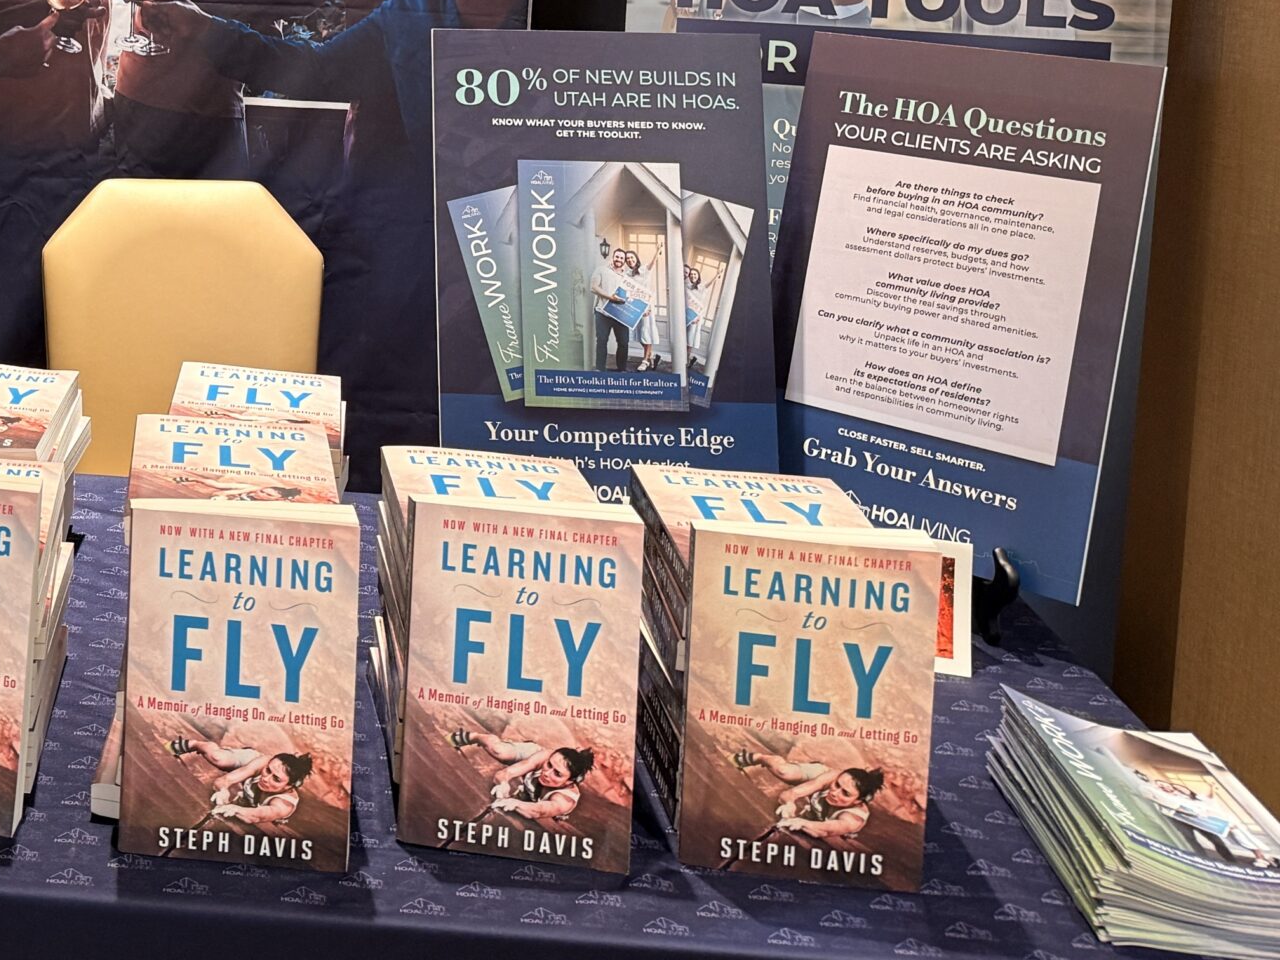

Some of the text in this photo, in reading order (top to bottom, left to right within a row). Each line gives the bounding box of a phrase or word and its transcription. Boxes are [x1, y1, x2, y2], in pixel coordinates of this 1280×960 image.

[552, 68, 735, 86] OF NEW BUILDS IN
[553, 90, 739, 109] UTAH ARE IN HOAs.
[491, 117, 705, 129] KNOW WHAT YOUR BUYERS NEED TO KNOW.
[555, 129, 641, 138] GET THE TOOLKIT.
[839, 90, 1106, 146] The HOA Questions
[834, 122, 1101, 173] YOUR CLIENTS ARE ASKING
[865, 185, 895, 197] before
[896, 190, 929, 203] buying
[930, 195, 940, 204] in
[956, 200, 978, 210] HOA
[981, 205, 1044, 221] community?
[894, 180, 1015, 205] Are there things to check
[531, 189, 558, 294] WORK
[866, 226, 1029, 261] Where specifically do my dues go?
[463, 218, 506, 308] WORK
[875, 281, 1000, 310] community living provide?
[888, 271, 990, 297] What value does HOA
[533, 292, 560, 363] Frame
[817, 309, 835, 318] Can
[835, 314, 853, 322] you
[855, 317, 884, 330] clarify
[886, 324, 910, 335] what
[920, 332, 976, 350] community
[977, 344, 1034, 361] association
[1035, 354, 1051, 364] is?
[200, 370, 322, 388] LEARNING
[537, 375, 677, 387] The HOA Toolkit Built for Realtors
[853, 367, 865, 377] its
[866, 373, 926, 391] expectations
[939, 389, 990, 406] residents?
[864, 360, 982, 393] How does an HOA define
[206, 384, 313, 409] FLY
[160, 424, 306, 441] LEARNING
[484, 421, 734, 455] Your Competitive Edge
[837, 427, 985, 471] CLOSE FASTER. SELL SMARTER.
[172, 441, 297, 471] FLY
[410, 455, 560, 474] LEARNING
[600, 458, 631, 470] HOA
[430, 474, 556, 501] FLY
[664, 475, 823, 495] LEARNING
[803, 437, 1016, 510] Grab Your Answers
[691, 495, 824, 526] FLY
[158, 547, 332, 592] LEARNING
[441, 540, 616, 588] LEARNING
[232, 591, 255, 611] to
[515, 586, 539, 605] to
[723, 565, 909, 612] LEARNING
[801, 611, 827, 630] to
[171, 614, 318, 703] FLY
[452, 607, 601, 697] FLY
[3, 675, 16, 688] Go
[735, 631, 893, 719] FLY
[158, 826, 312, 860] STEPH DAVIS
[437, 818, 593, 859] STEPH DAVIS
[720, 837, 882, 875] STEPH DAVIS
